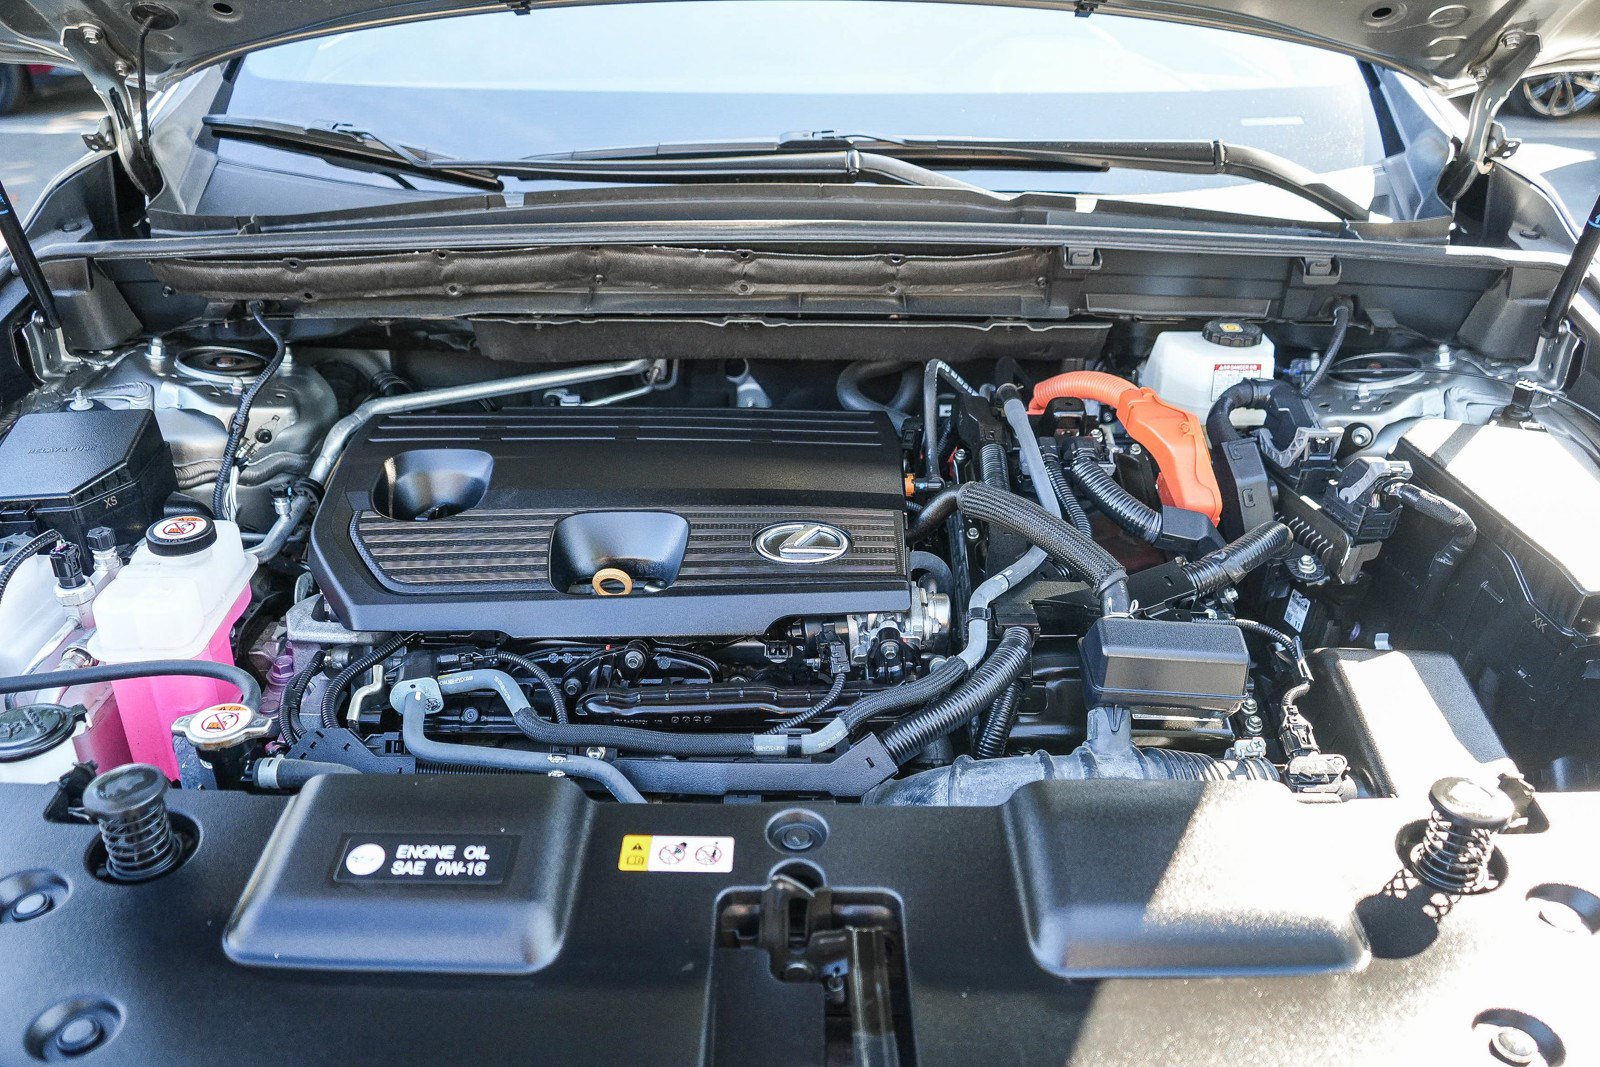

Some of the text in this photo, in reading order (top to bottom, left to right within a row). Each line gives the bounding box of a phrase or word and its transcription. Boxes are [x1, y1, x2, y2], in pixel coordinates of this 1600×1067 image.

[104, 495, 118, 509] XS
[1531, 613, 1548, 633] XK
[395, 844, 490, 860] ENGINE OIL
[391, 860, 427, 876] SAE
